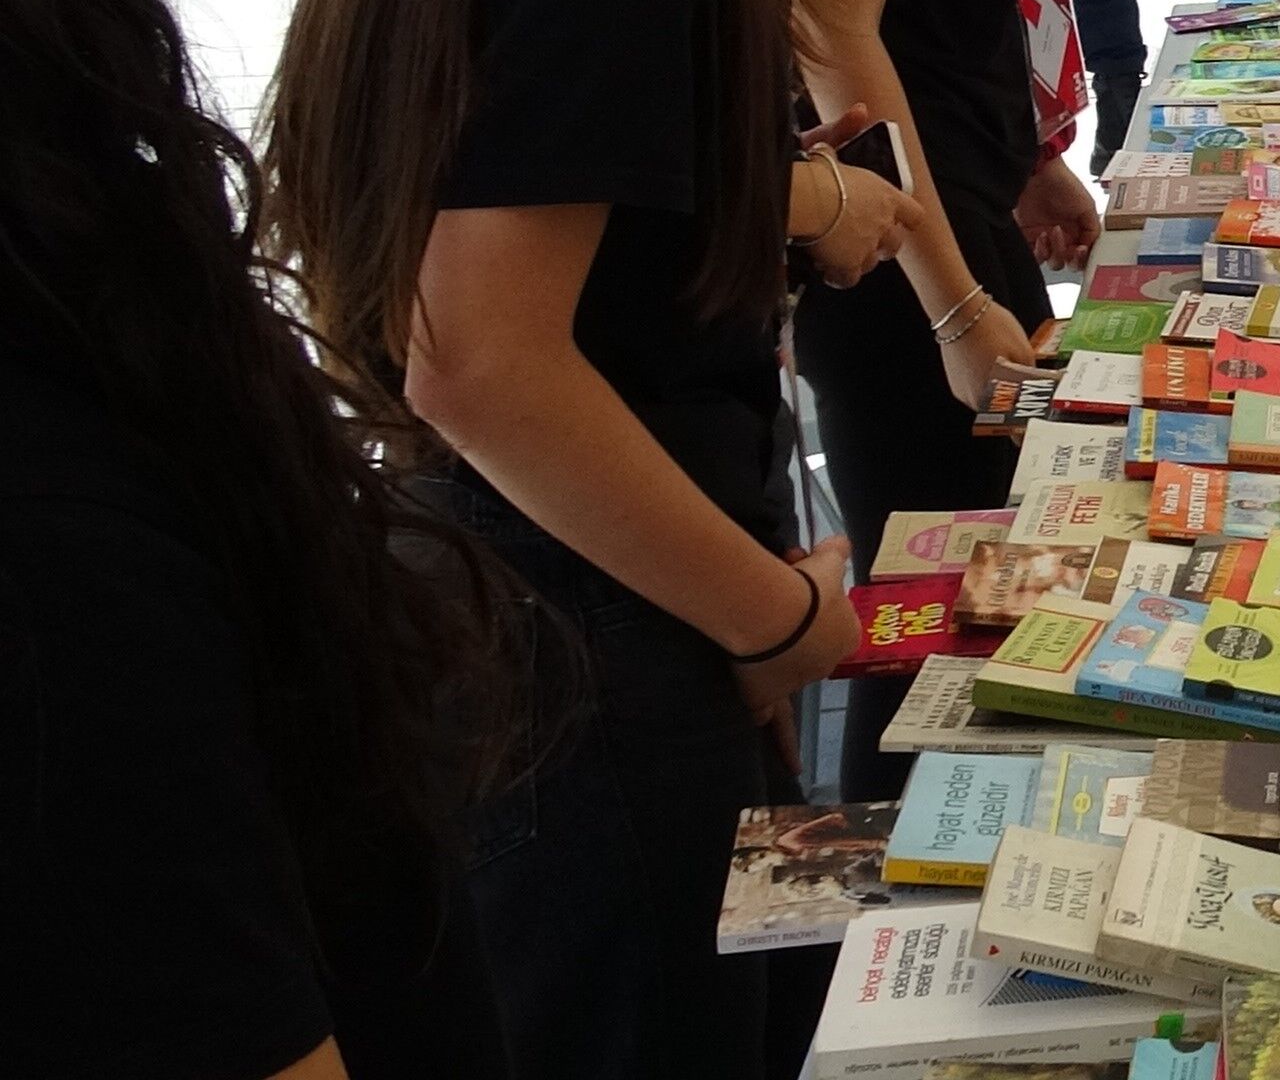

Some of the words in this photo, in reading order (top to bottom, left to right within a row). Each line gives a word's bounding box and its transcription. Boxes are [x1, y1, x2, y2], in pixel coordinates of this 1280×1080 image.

[1011, 620, 1058, 664] ROBINSON
[925, 810, 963, 851] hayat
[944, 764, 976, 808] neden
[976, 781, 1011, 837] güzeldir
[1043, 866, 1070, 913] KIRMIZI
[1065, 871, 1094, 920] PAPAĞAN
[858, 966, 883, 1003] behçet
[1020, 950, 1082, 976] KIRMIZI
[1084, 963, 1153, 987] PAPAĞAN
